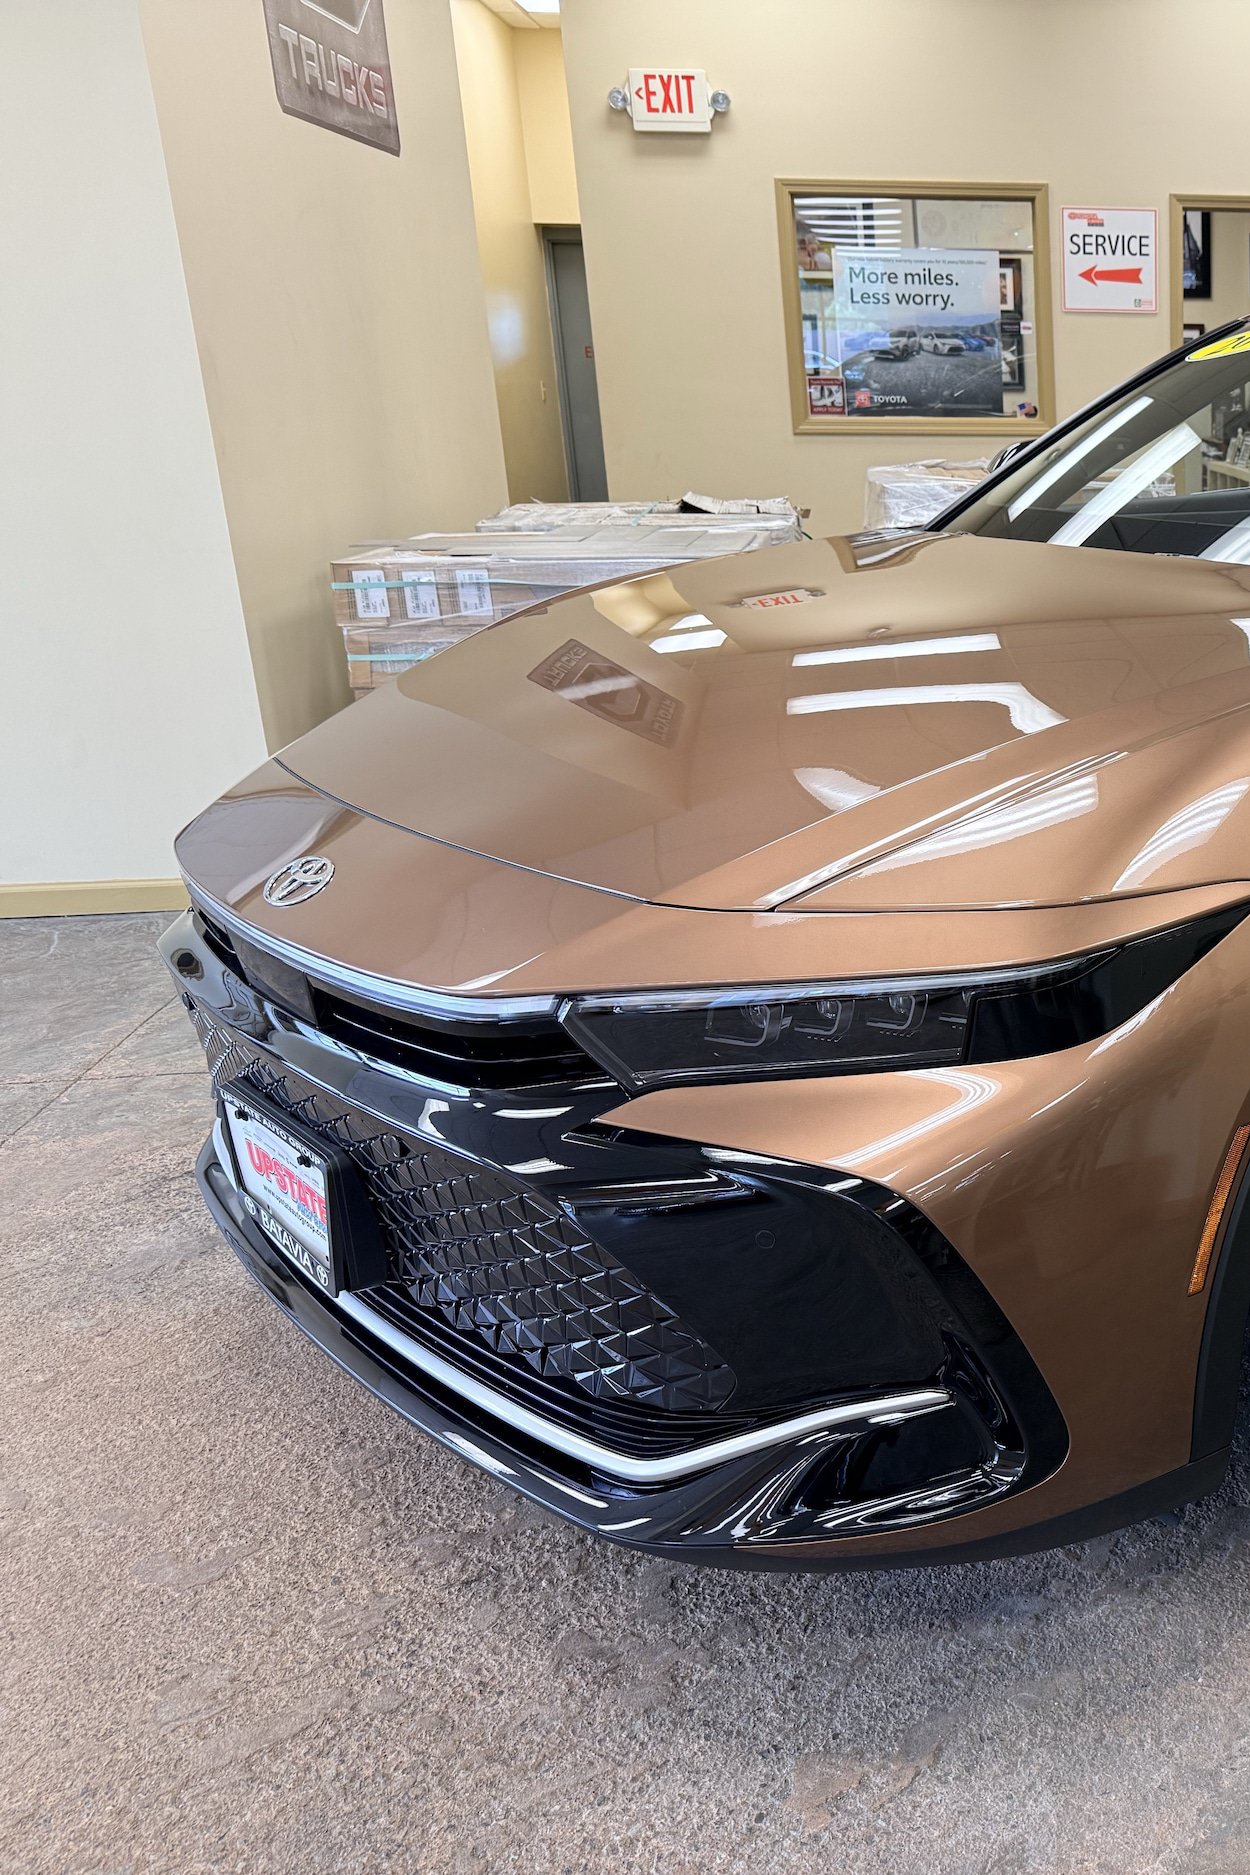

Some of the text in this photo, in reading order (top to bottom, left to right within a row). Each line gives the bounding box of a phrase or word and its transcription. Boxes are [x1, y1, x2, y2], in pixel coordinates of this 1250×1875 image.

[278, 22, 389, 120] TRUCKS
[643, 74, 695, 114] EXIT
[1069, 233, 1150, 257] SERVICE
[848, 266, 959, 286] More miles.
[850, 287, 955, 310] Less worry.
[873, 395, 908, 404] TOYOTA
[220, 1089, 264, 1121] UPSTATE
[263, 1119, 287, 1140] AUTO
[288, 1137, 321, 1165] GROUP
[245, 1137, 328, 1225] UPSTATE
[260, 1210, 315, 1275] BATAVIA
